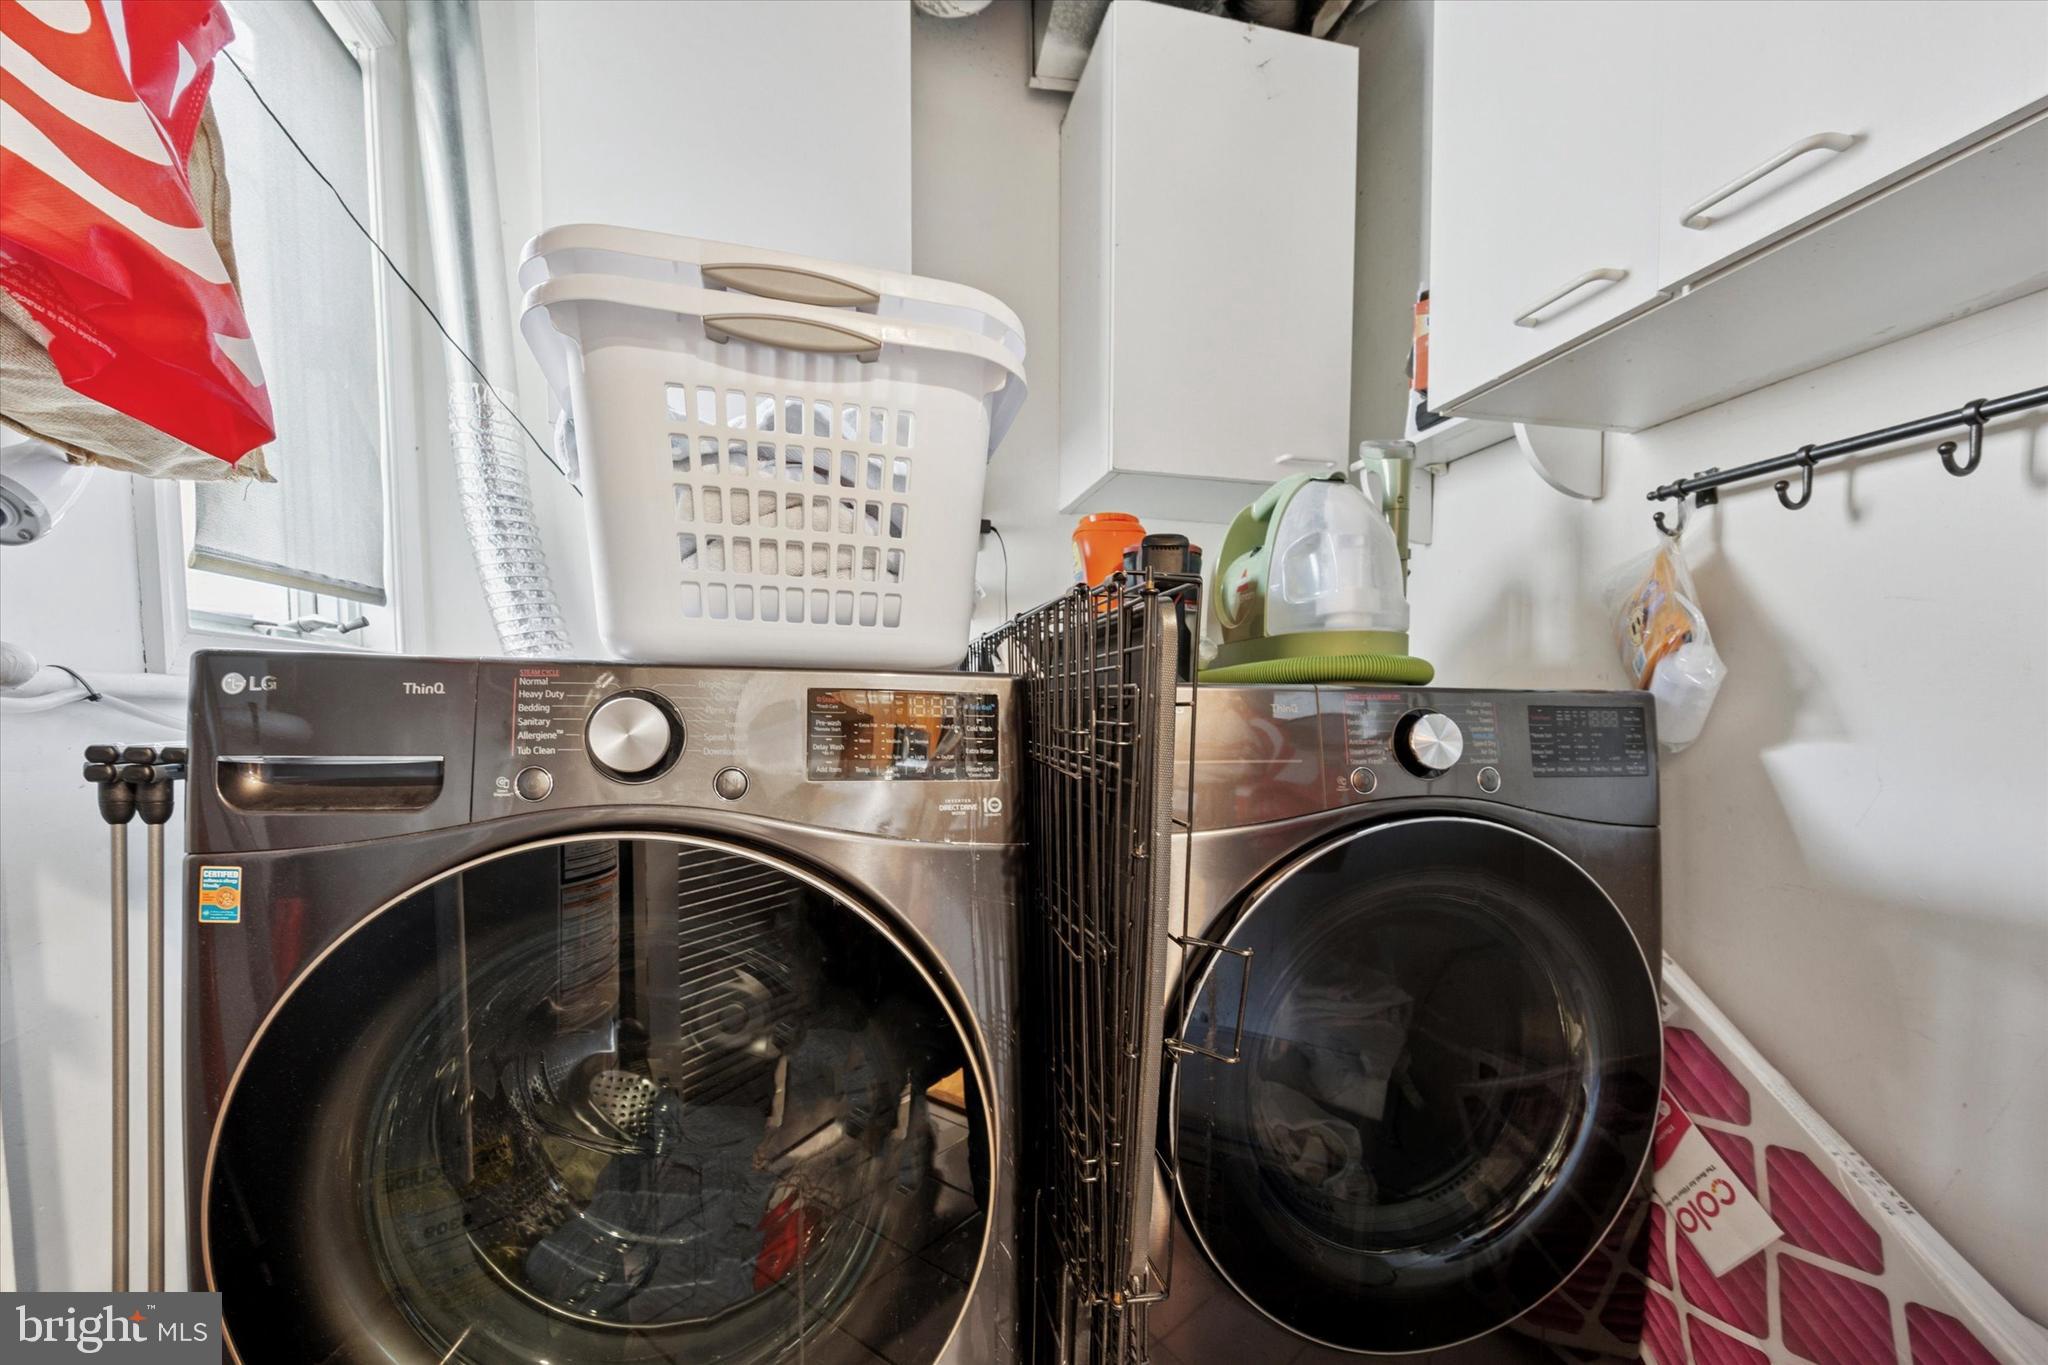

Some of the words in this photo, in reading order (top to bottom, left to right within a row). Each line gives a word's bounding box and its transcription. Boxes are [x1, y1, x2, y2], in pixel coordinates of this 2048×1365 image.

[11, 291, 45, 314] made
[250, 675, 277, 691] LG
[519, 677, 549, 686] Normal
[403, 682, 445, 695] ThinQ
[518, 690, 543, 700] Heavy
[545, 690, 565, 700] Duty
[518, 703, 550, 714] Bedding
[517, 717, 551, 727] Sanitary
[517, 746, 531, 755] Tub
[533, 746, 556, 755] Clean
